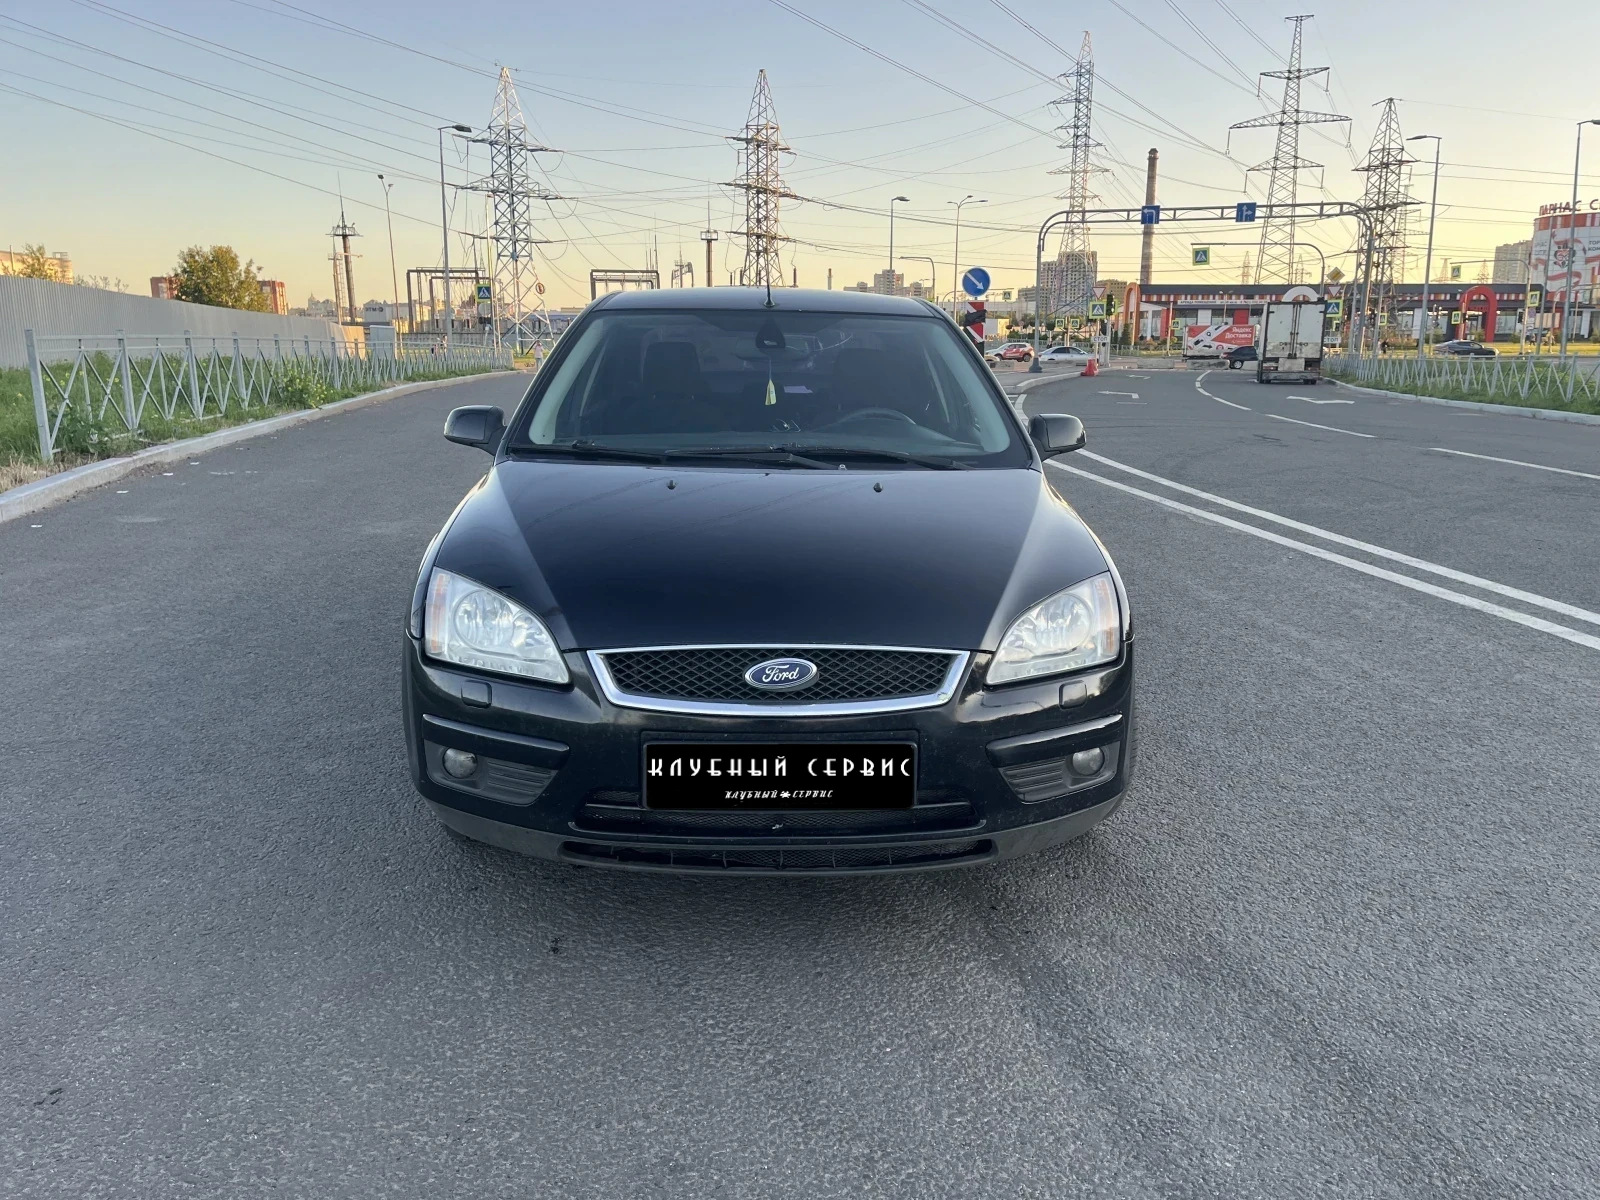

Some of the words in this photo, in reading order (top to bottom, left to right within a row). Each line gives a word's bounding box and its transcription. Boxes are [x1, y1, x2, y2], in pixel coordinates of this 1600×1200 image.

[1539, 200, 1582, 216] ПАРНАС
[1590, 198, 1600, 211] С
[762, 665, 800, 682] Ford
